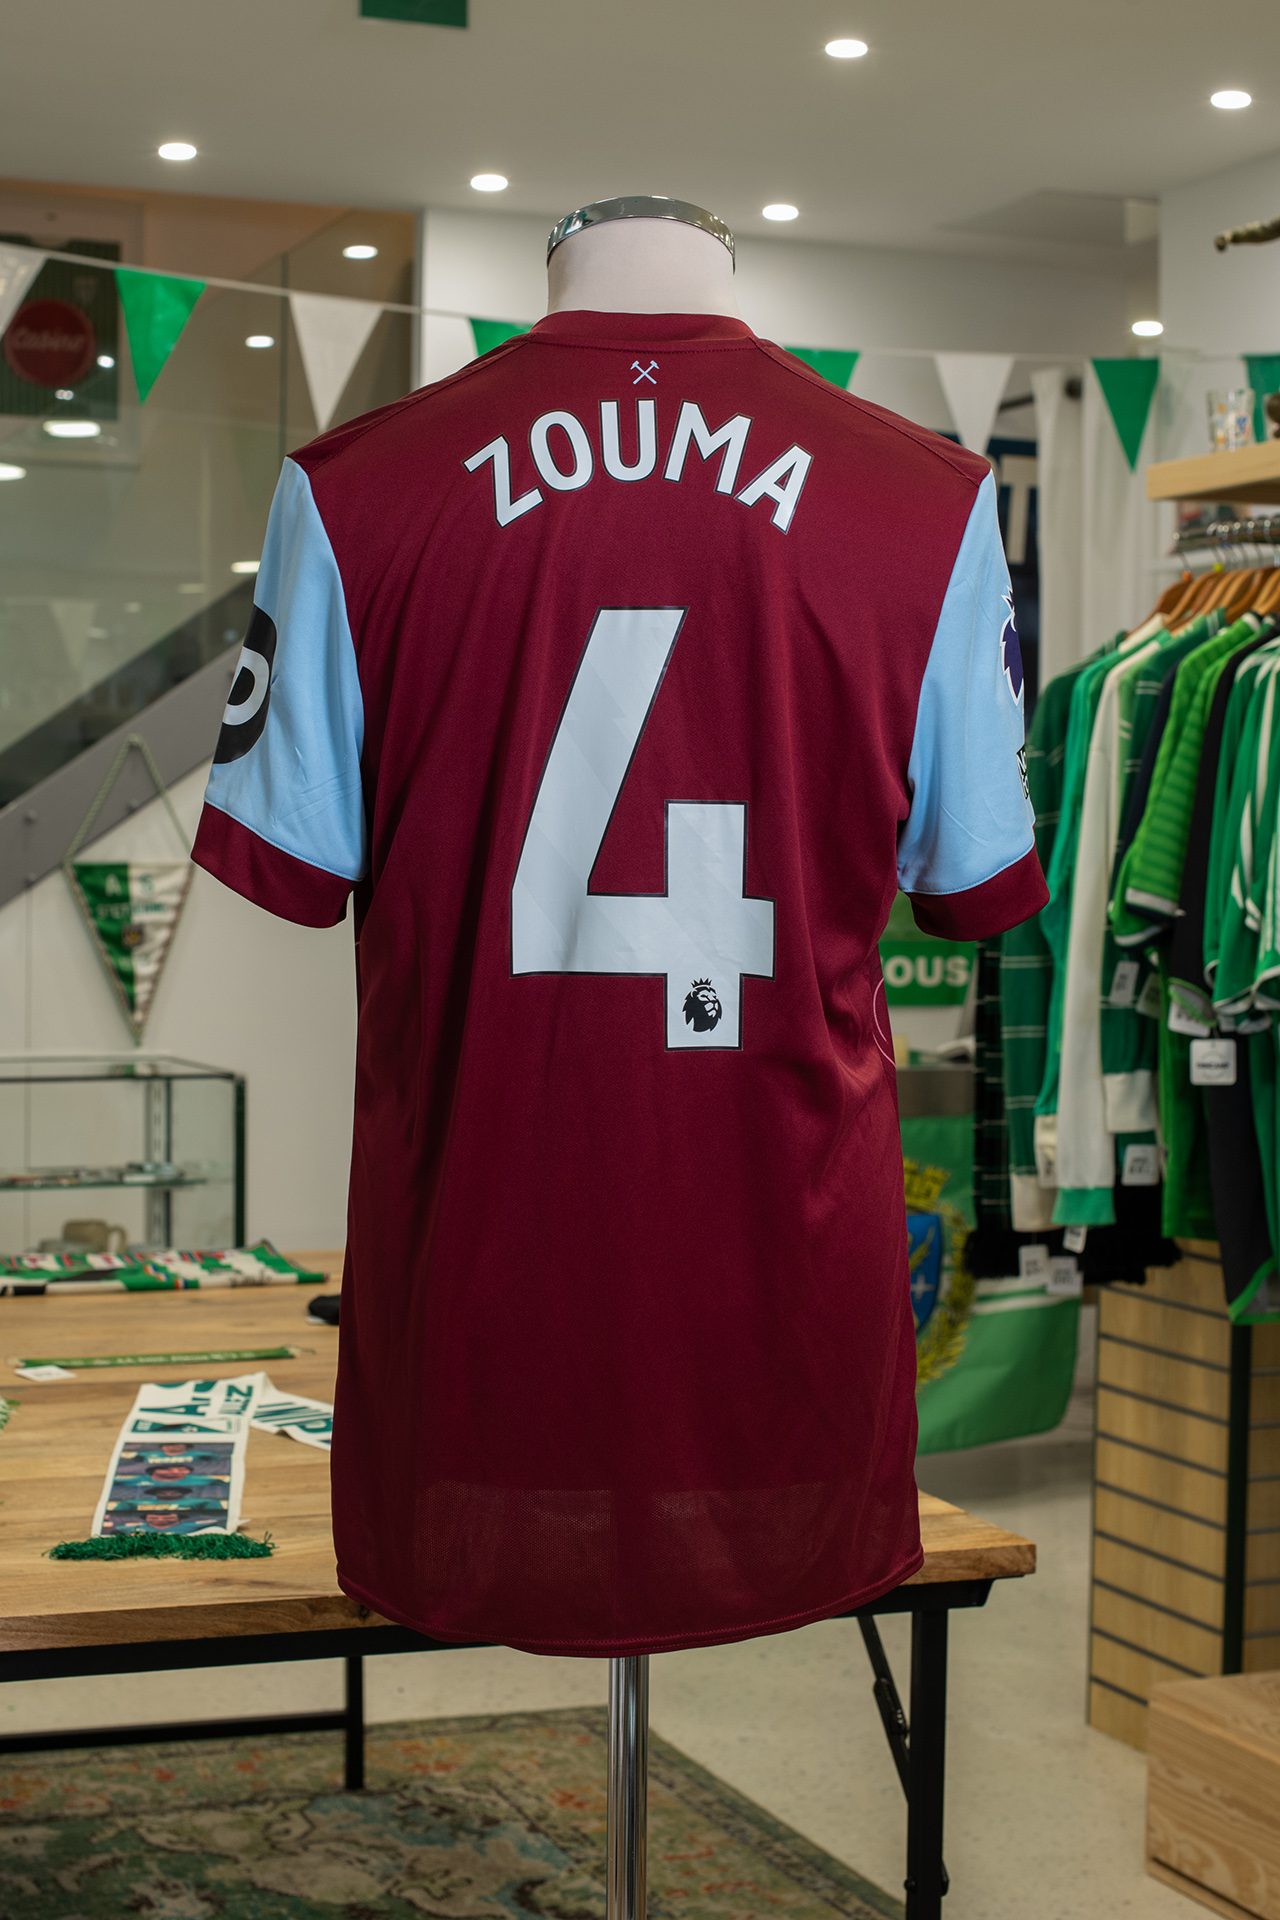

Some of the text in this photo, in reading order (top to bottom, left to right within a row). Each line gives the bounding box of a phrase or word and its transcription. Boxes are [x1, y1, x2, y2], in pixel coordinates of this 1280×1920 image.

[463, 399, 813, 533] ZOUMA
[511, 606, 776, 1051] 4
[881, 954, 969, 988] OUS
